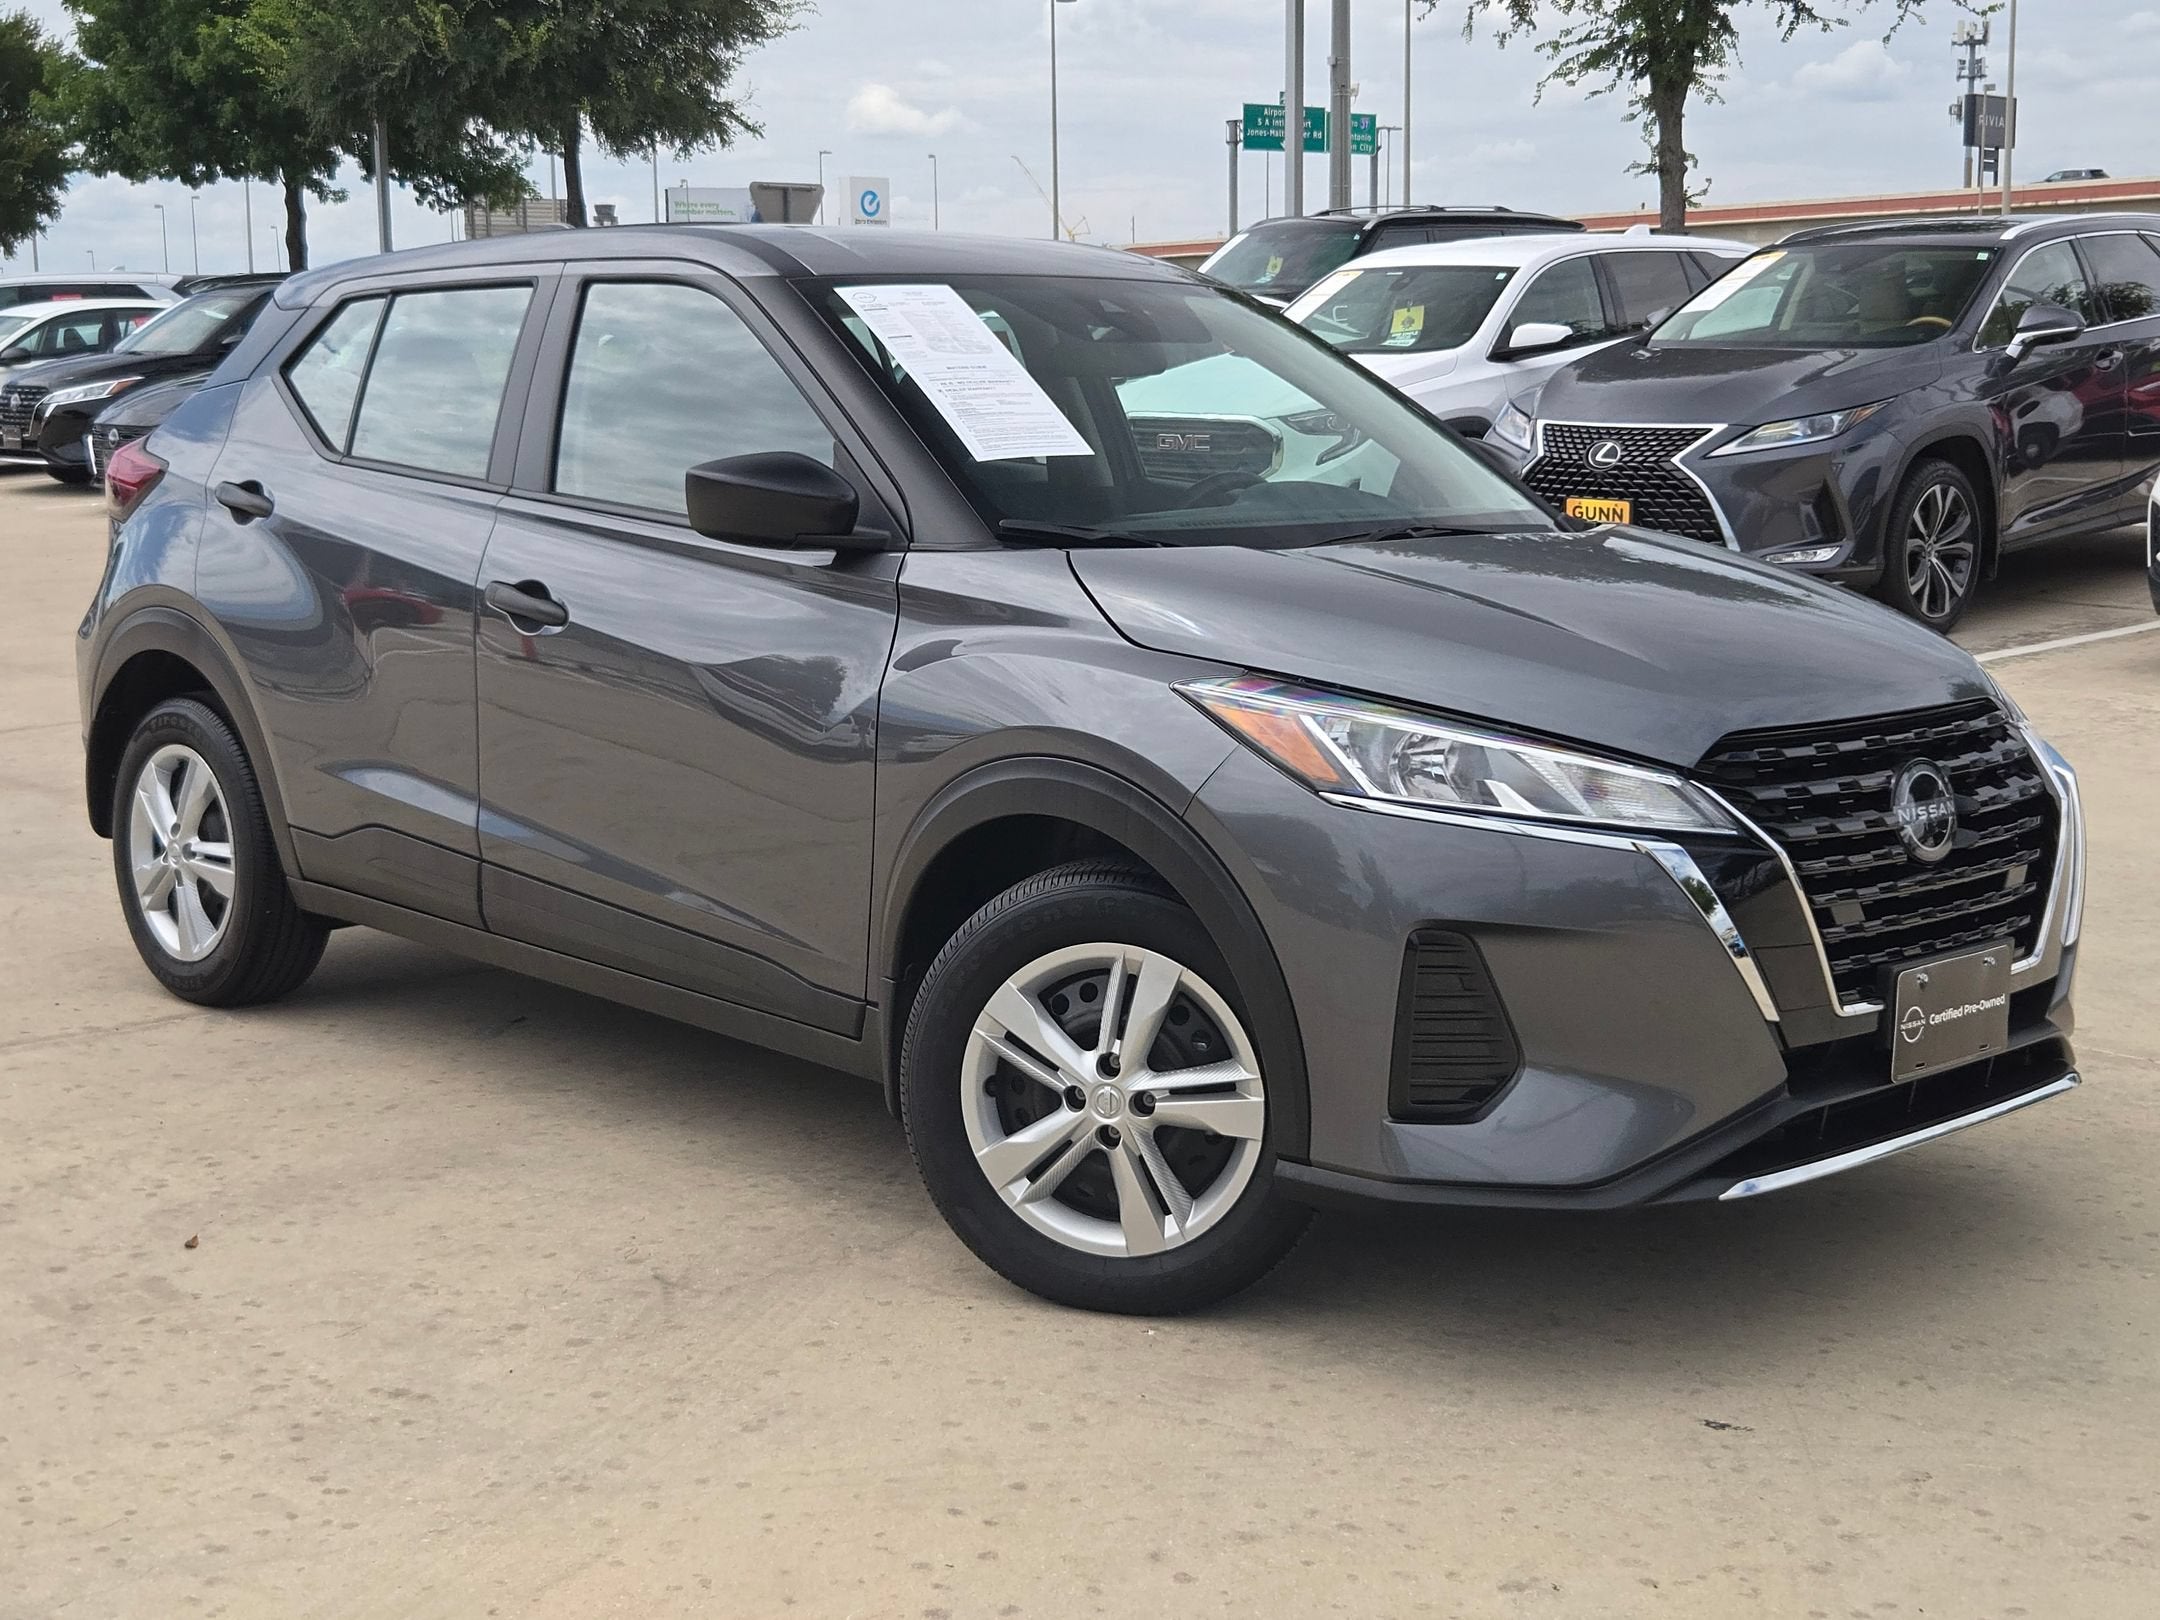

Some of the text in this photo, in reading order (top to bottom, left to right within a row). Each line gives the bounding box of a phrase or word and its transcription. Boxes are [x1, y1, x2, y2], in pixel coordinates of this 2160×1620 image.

[1263, 107, 1286, 118] Airpor
[1264, 118, 1270, 126] A
[1978, 114, 2006, 128] RIVIA
[1312, 130, 1322, 139] Rd
[1359, 143, 1373, 154] City
[1156, 433, 1211, 451] GMC
[1572, 505, 1624, 523] GUNN
[1897, 801, 1955, 823] NISSAN
[1900, 993, 2006, 1031] NISSAN Certified Pre-Owned
